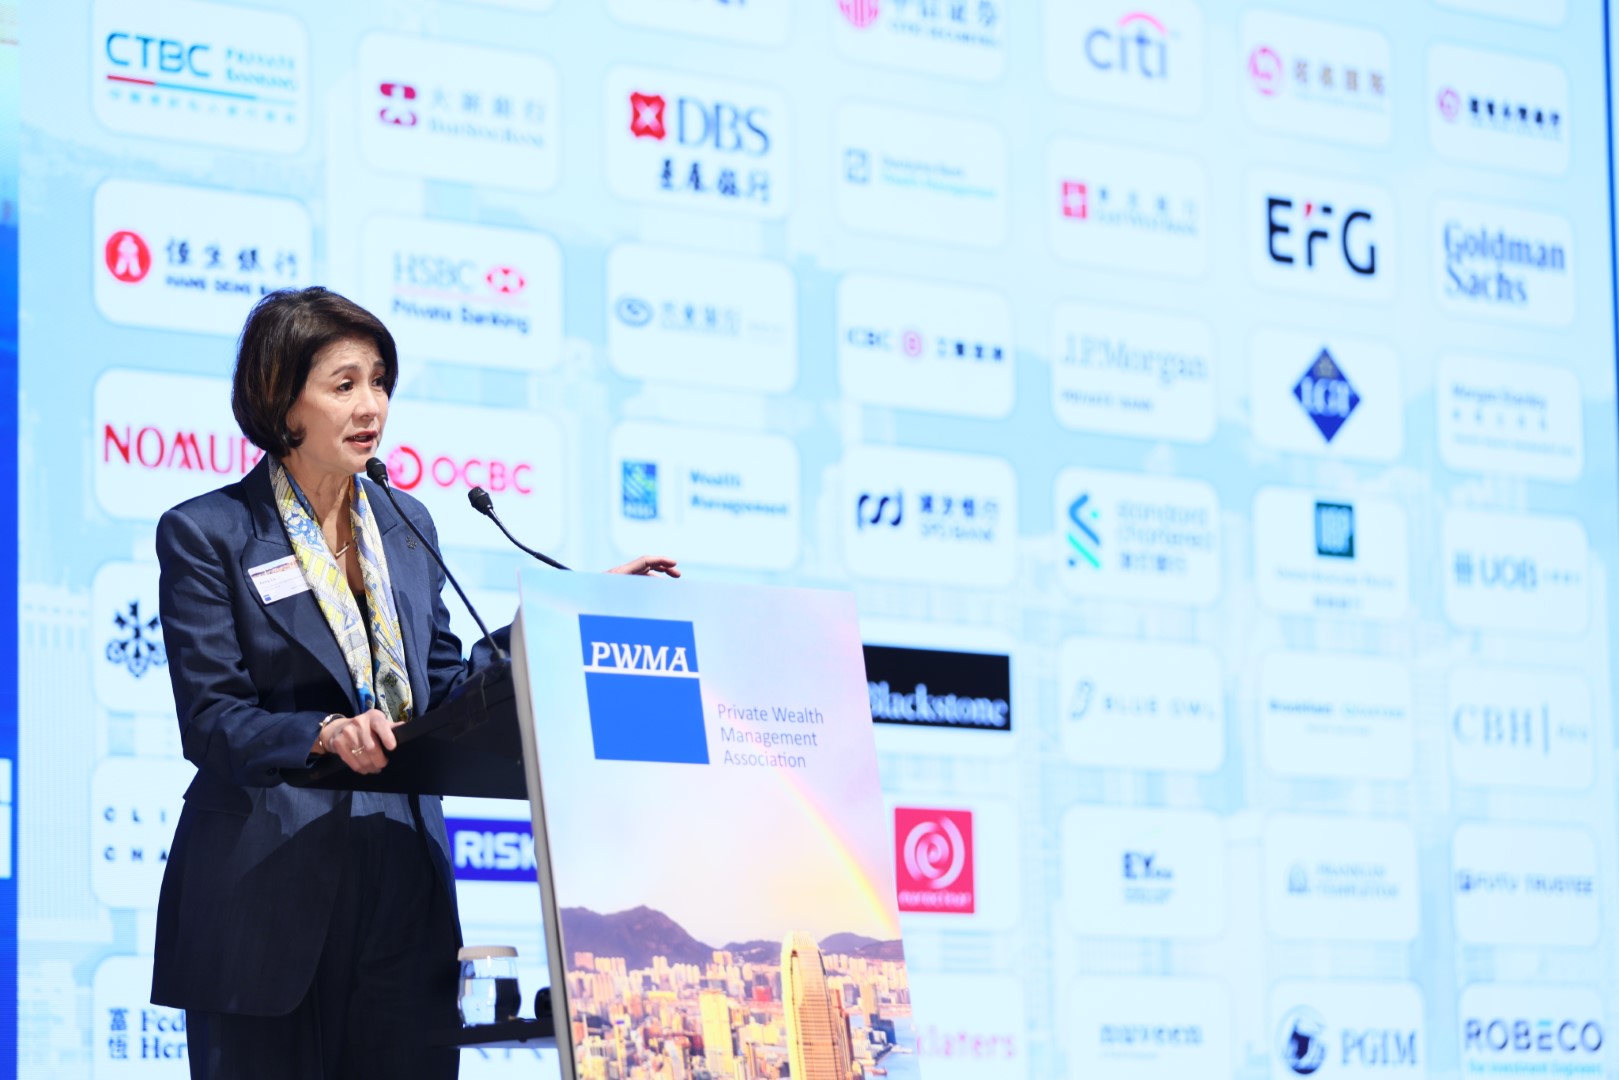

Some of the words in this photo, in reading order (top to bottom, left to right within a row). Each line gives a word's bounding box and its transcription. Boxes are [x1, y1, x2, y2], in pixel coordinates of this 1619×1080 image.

[106, 32, 211, 79] CTBC
[1084, 27, 1170, 80] citi
[677, 96, 772, 158] DBS
[1266, 196, 1376, 275] EFG
[1443, 219, 1567, 271] Goldman
[392, 252, 477, 294] HSBC
[1445, 264, 1529, 308] Sachs
[392, 298, 452, 321] Private
[461, 306, 531, 335] Banking
[104, 424, 267, 476] NOMUR
[432, 456, 534, 496] OCBC
[690, 469, 742, 487] Wealth
[690, 494, 788, 515] Management
[1480, 556, 1539, 590] UOB
[591, 641, 690, 672] PWMA
[717, 703, 768, 722] Private
[771, 706, 825, 725] Wealth
[1453, 702, 1533, 747] CBH
[720, 727, 819, 748] Management
[723, 749, 807, 769] Association
[103, 806, 168, 824] CLI
[103, 845, 168, 862] CHA
[141, 1008, 187, 1032] Fed
[1463, 1017, 1604, 1053] ROBECO
[141, 1037, 189, 1060] Her
[1340, 1029, 1418, 1067] PGIM
